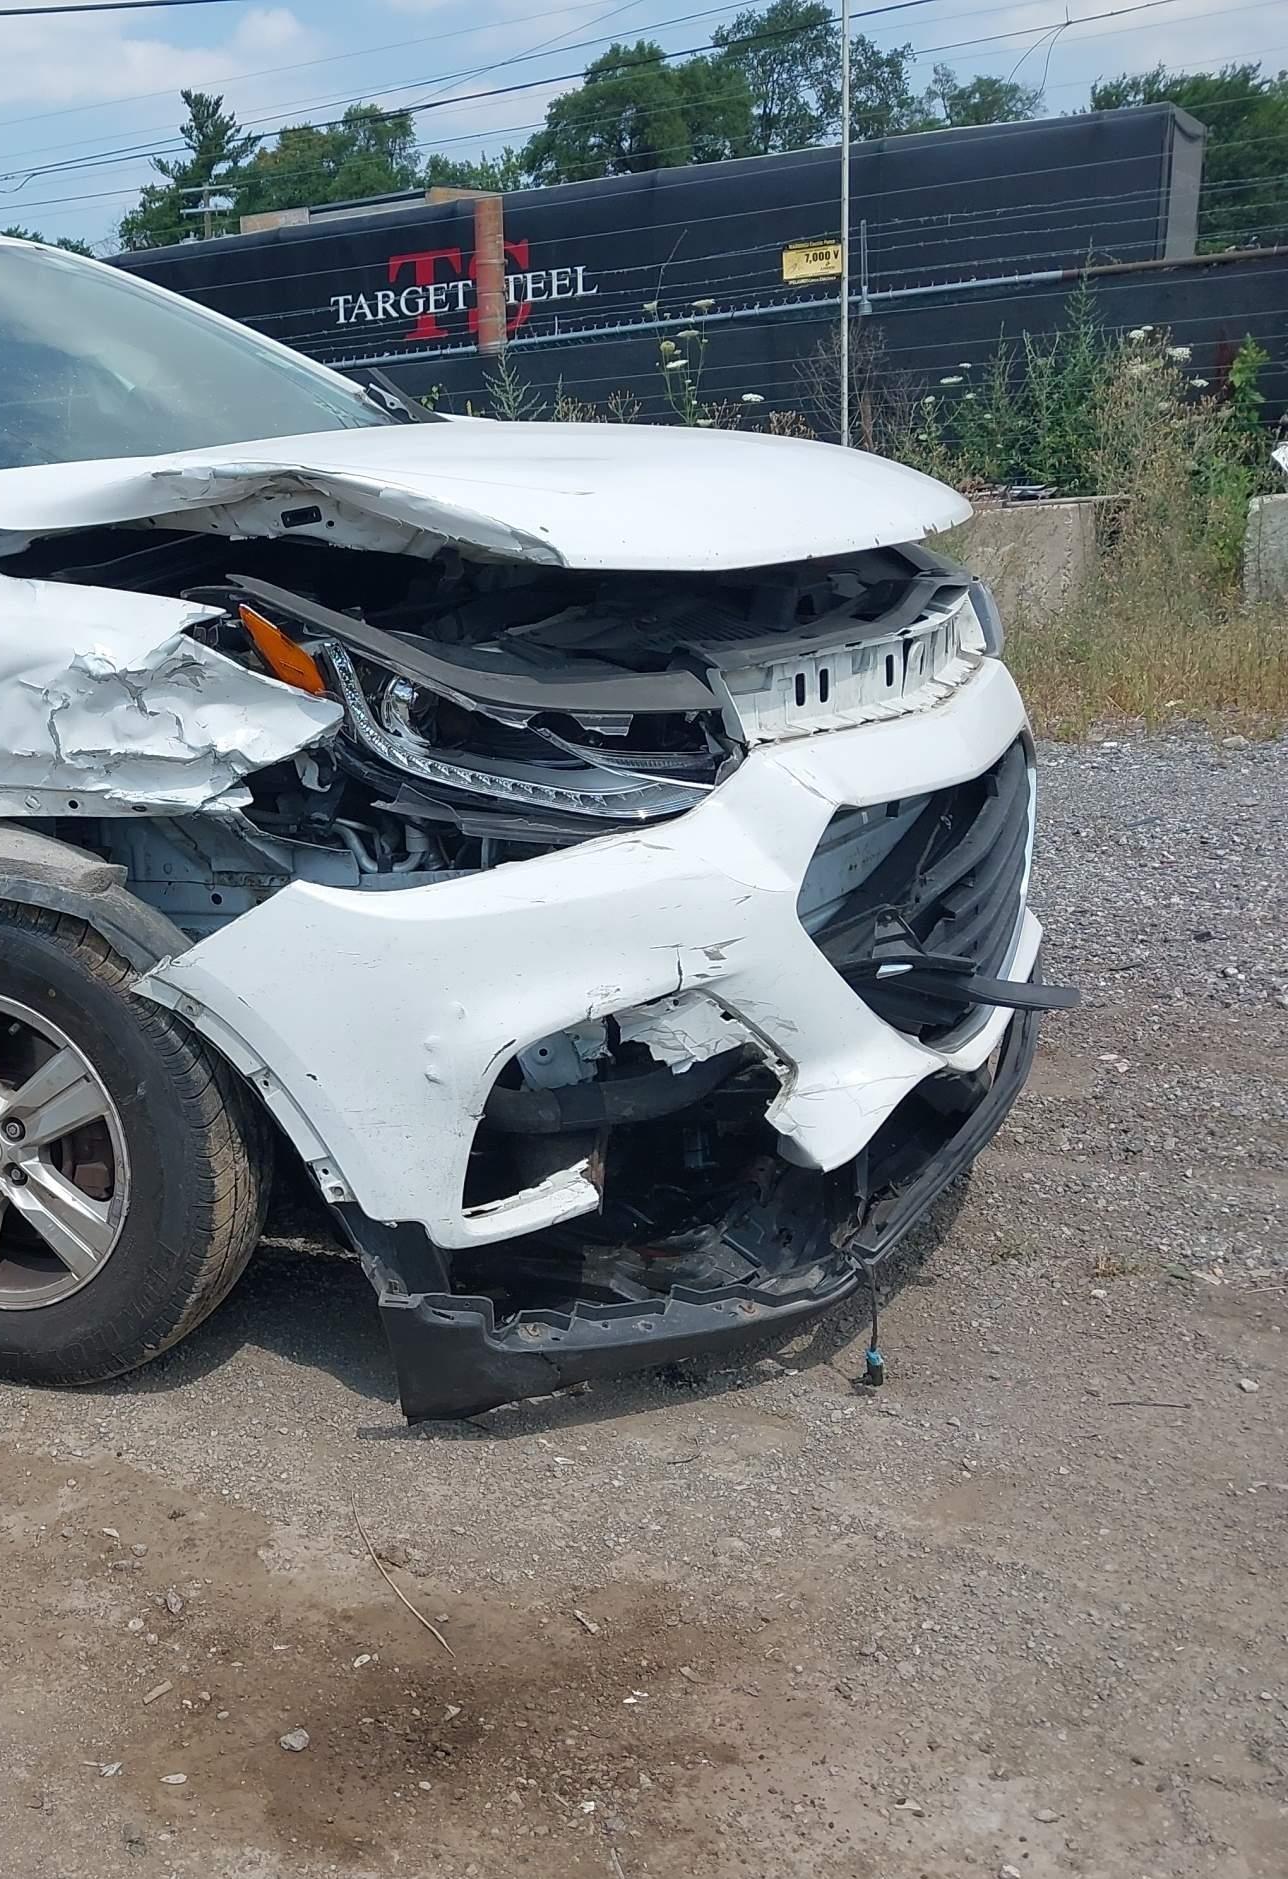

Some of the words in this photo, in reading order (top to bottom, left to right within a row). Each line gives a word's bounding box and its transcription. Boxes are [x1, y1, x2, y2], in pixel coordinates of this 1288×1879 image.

[804, 250, 831, 264] 7,000
[833, 249, 839, 260] V
[330, 279, 473, 325] TARGET
[502, 265, 599, 305] TEEL
